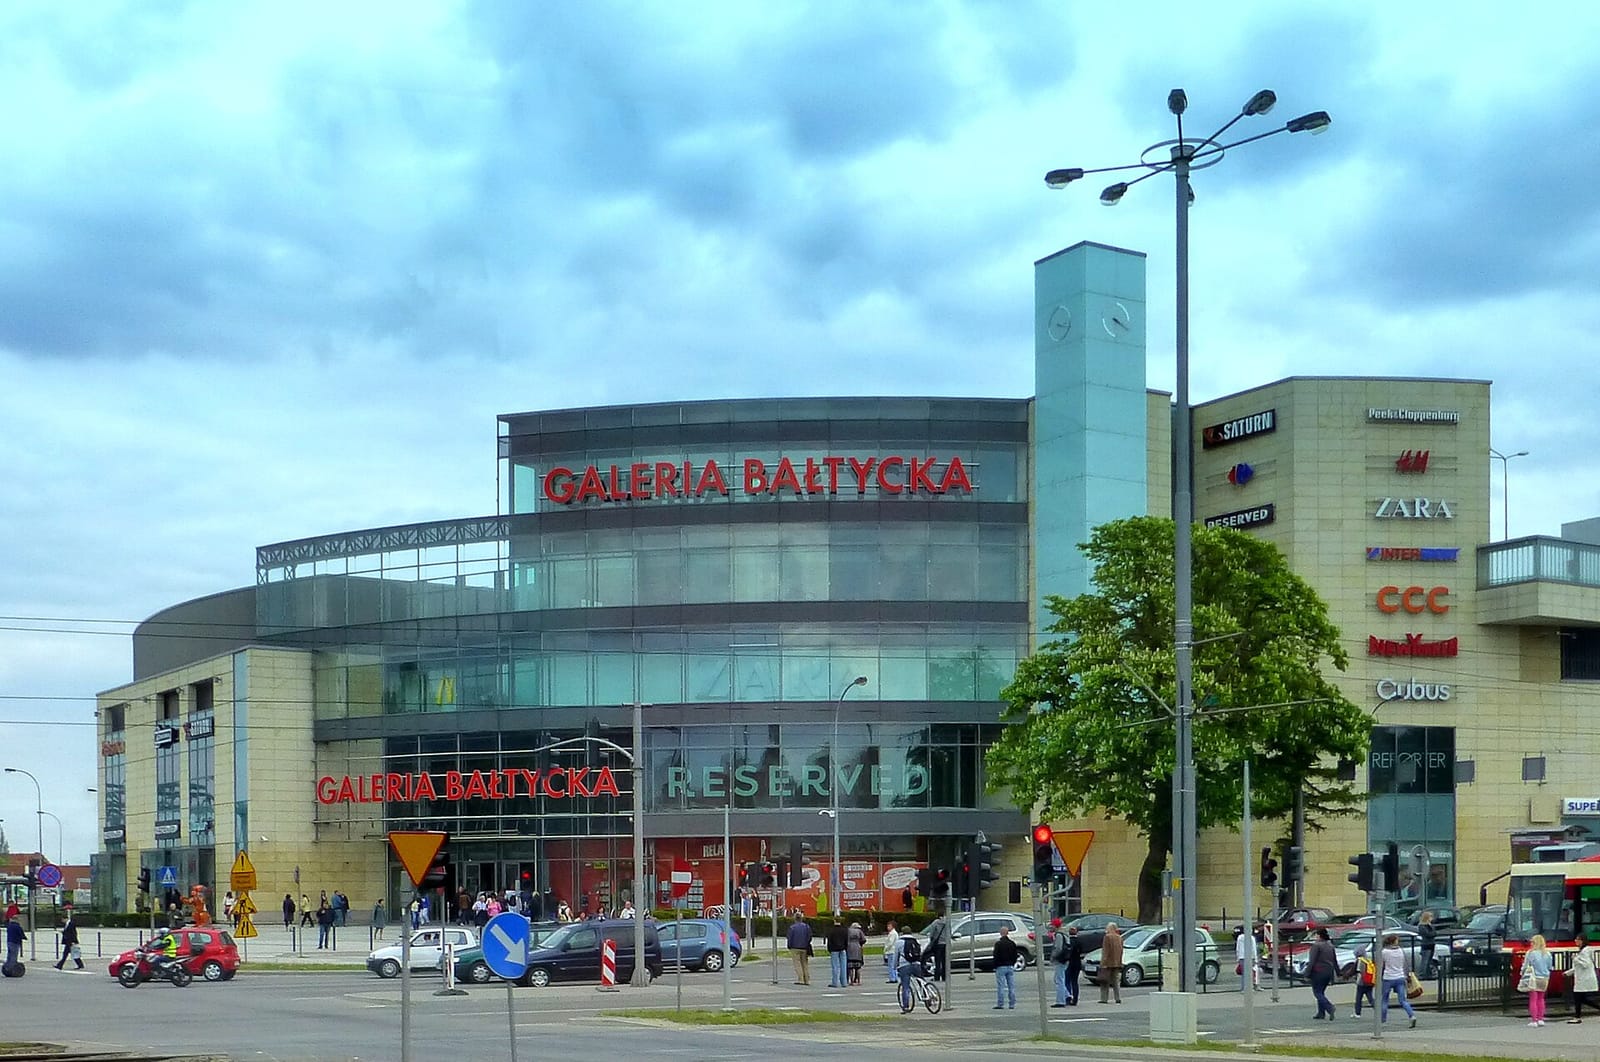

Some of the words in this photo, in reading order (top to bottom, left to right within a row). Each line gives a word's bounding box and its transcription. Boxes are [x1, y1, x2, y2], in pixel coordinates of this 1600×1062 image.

[1223, 412, 1273, 440] SATURN
[543, 459, 728, 505] GALERIA
[743, 456, 972, 494] BAŁTYCKA
[1207, 509, 1269, 529] RESERVED
[1375, 497, 1453, 519] ZARA
[1376, 585, 1450, 614] CCC
[1376, 677, 1451, 701] Cubus
[316, 771, 437, 805] GALERIA
[446, 766, 619, 800] BAŁTYCKA
[667, 764, 930, 799] RESERVED
